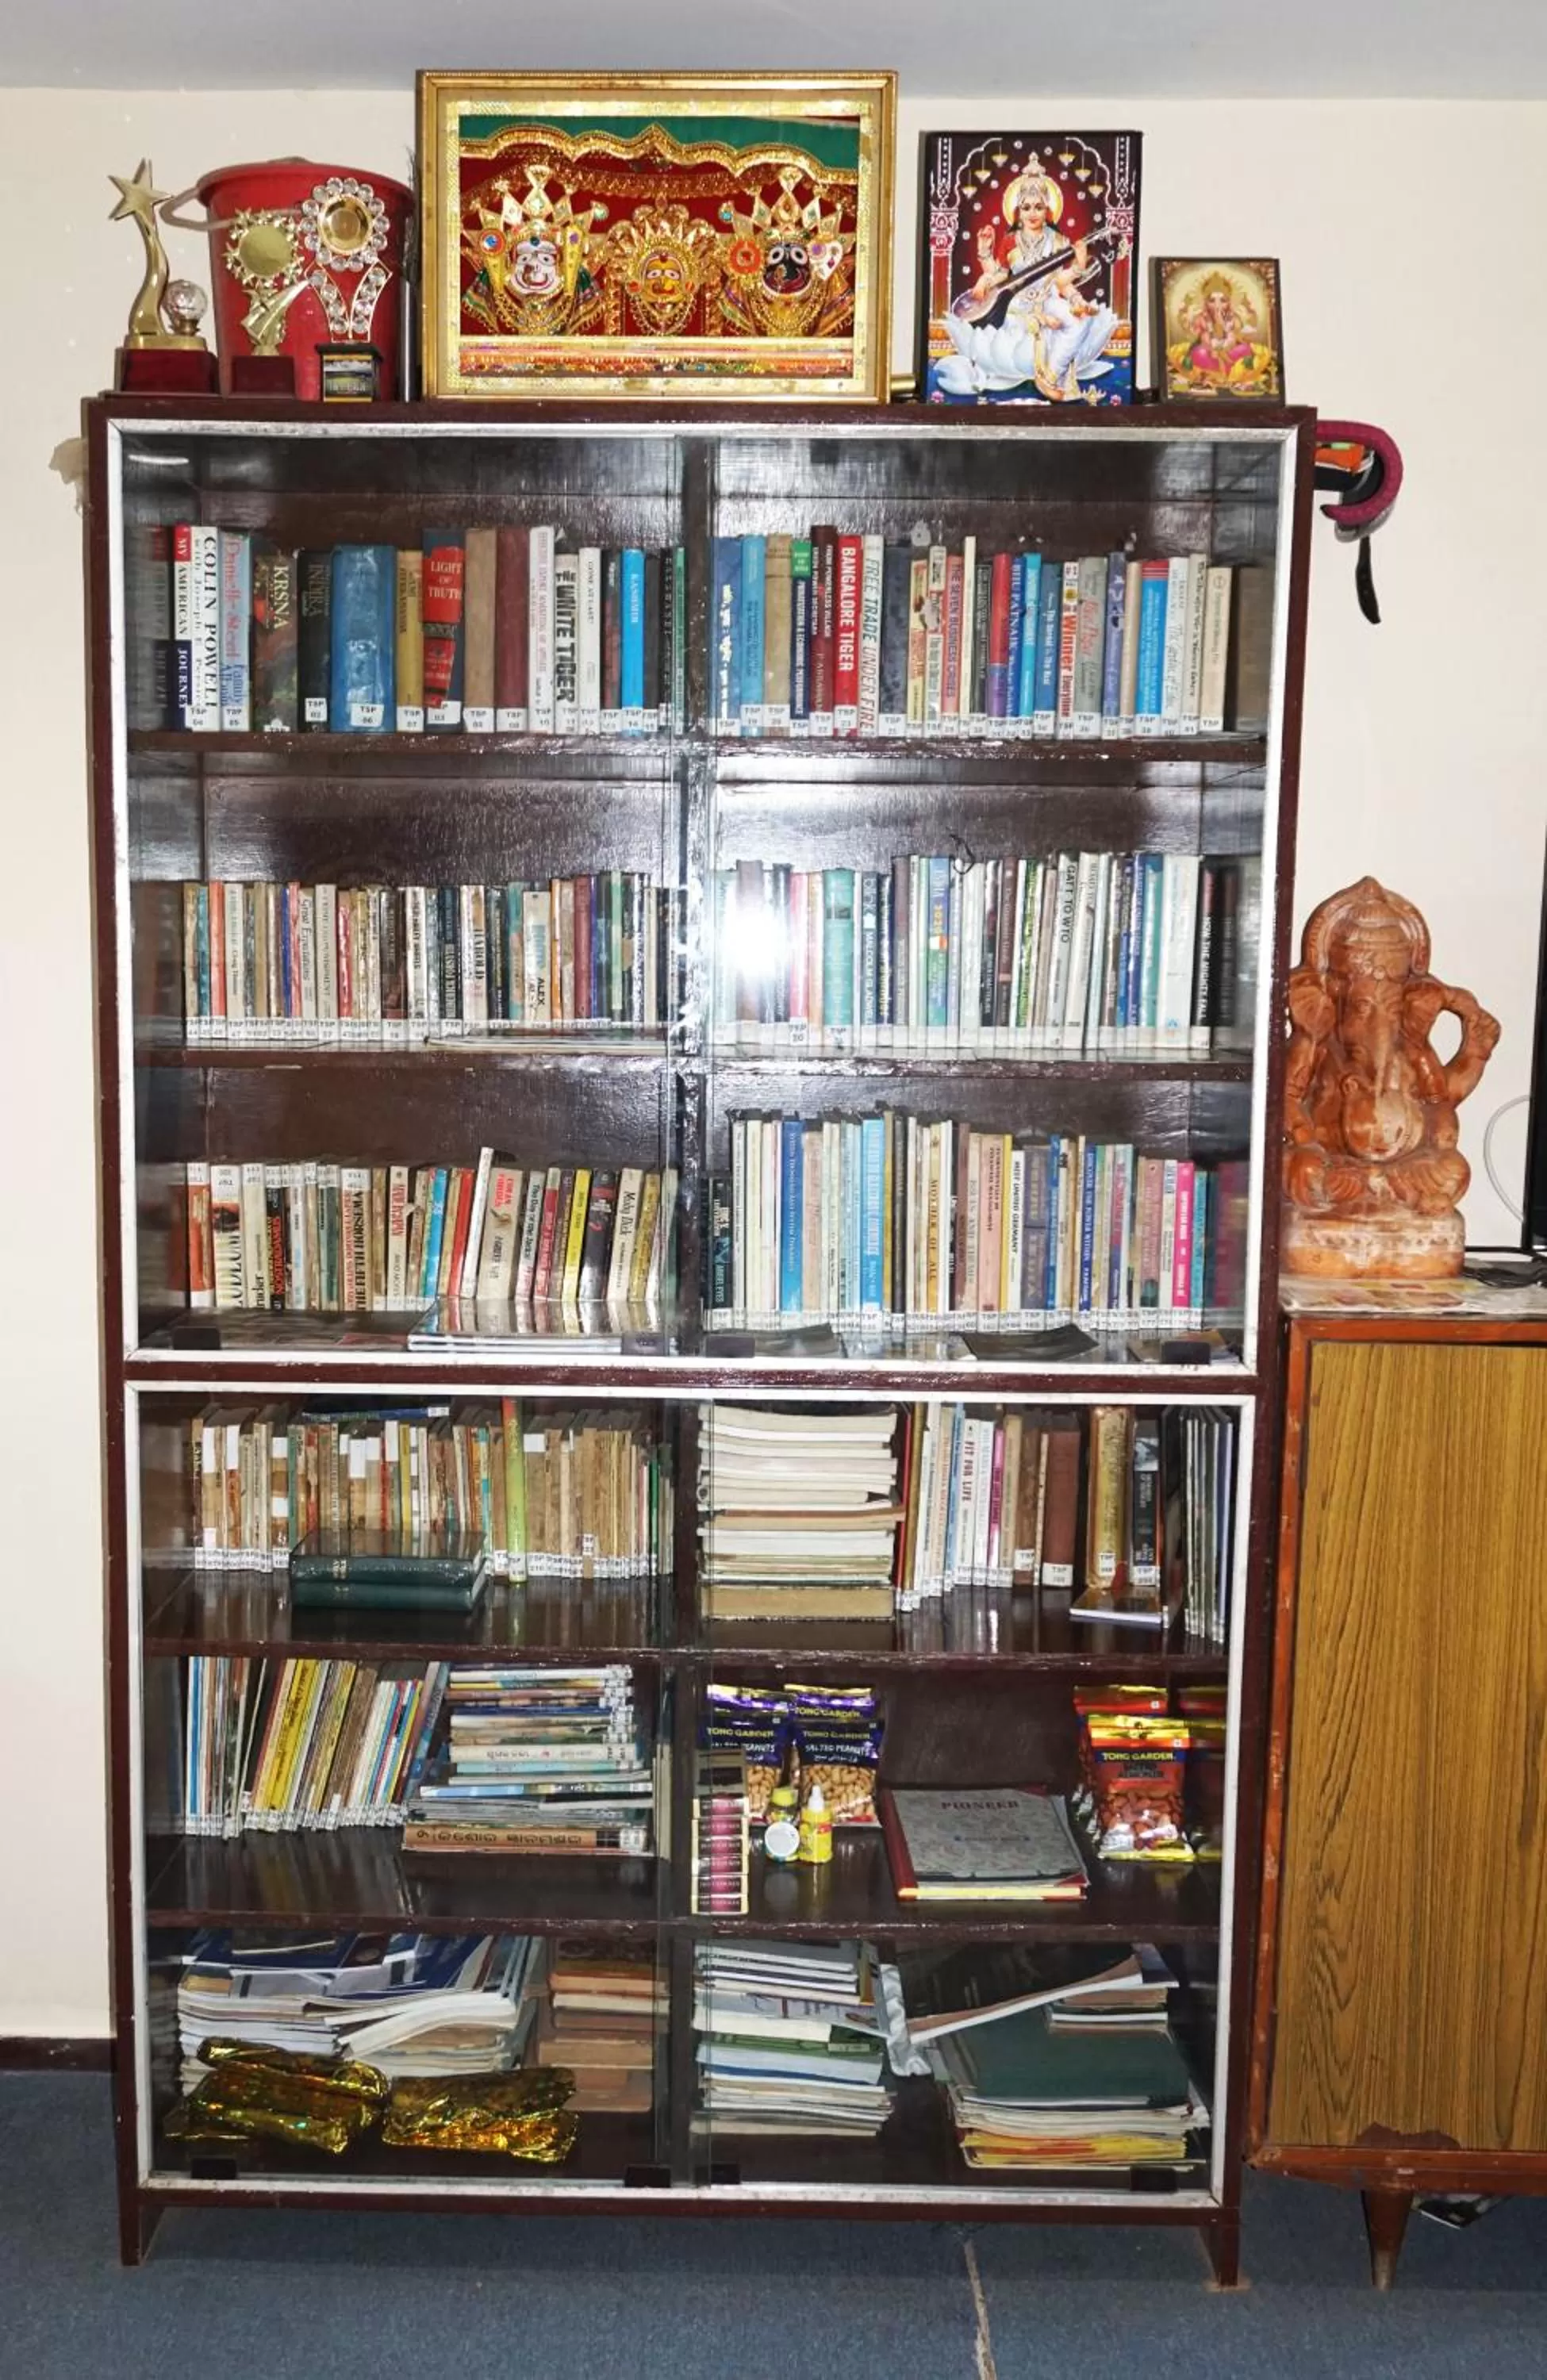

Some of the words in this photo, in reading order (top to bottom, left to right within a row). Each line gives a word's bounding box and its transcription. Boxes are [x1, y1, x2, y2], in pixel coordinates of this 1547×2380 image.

[177, 537, 189, 557] MY
[204, 536, 217, 610] COLIN
[224, 536, 242, 610] Danielle
[430, 561, 463, 573] LIGHT
[555, 570, 577, 583] THE
[864, 558, 880, 598] FREE
[177, 566, 189, 635] AMERICAN
[273, 564, 290, 629] KRSNA
[308, 564, 326, 617] INDIRA
[428, 586, 462, 599] TRUTH
[839, 546, 856, 628] BANGALORE
[556, 585, 576, 639] WHITE
[862, 597, 878, 643] TRADE
[839, 631, 854, 671] TIGER
[948, 616, 960, 663] BUSINESS
[1061, 613, 1077, 672] Winner
[177, 647, 189, 709] JOURNEY
[555, 642, 576, 704] TIGER
[861, 645, 877, 696] UNDER
[1061, 675, 1073, 718] Everytime
[859, 697, 875, 729] FIRE
[1064, 864, 1076, 895] GATT
[301, 898, 312, 924] Great
[1062, 898, 1073, 914] TO
[1060, 916, 1071, 944] WTO
[1201, 941, 1211, 958] THE
[1200, 960, 1210, 996] MIGHTY
[1198, 998, 1207, 1020] FALL
[529, 1199, 539, 1213] Day
[532, 1184, 540, 1198] The
[620, 1190, 635, 1215] Moby
[928, 1179, 939, 1228] MOTHER
[351, 1190, 364, 1250] HORSEMA
[619, 1215, 634, 1236] Dick
[216, 1234, 243, 1307] UDLUM
[353, 1251, 366, 1287] FIFTH
[715, 1286, 724, 1303] EYES
[964, 1441, 975, 1456] FIT
[962, 1459, 973, 1476] FOR
[962, 1480, 973, 1502] LIFE
[822, 1706, 861, 1718] GARDEN
[707, 1727, 733, 1736] TONG
[735, 1728, 774, 1737] GARDEN
[835, 1745, 870, 1756] PEANUTS
[1102, 1752, 1130, 1760] TONG
[1131, 1752, 1173, 1761] GARDEN
